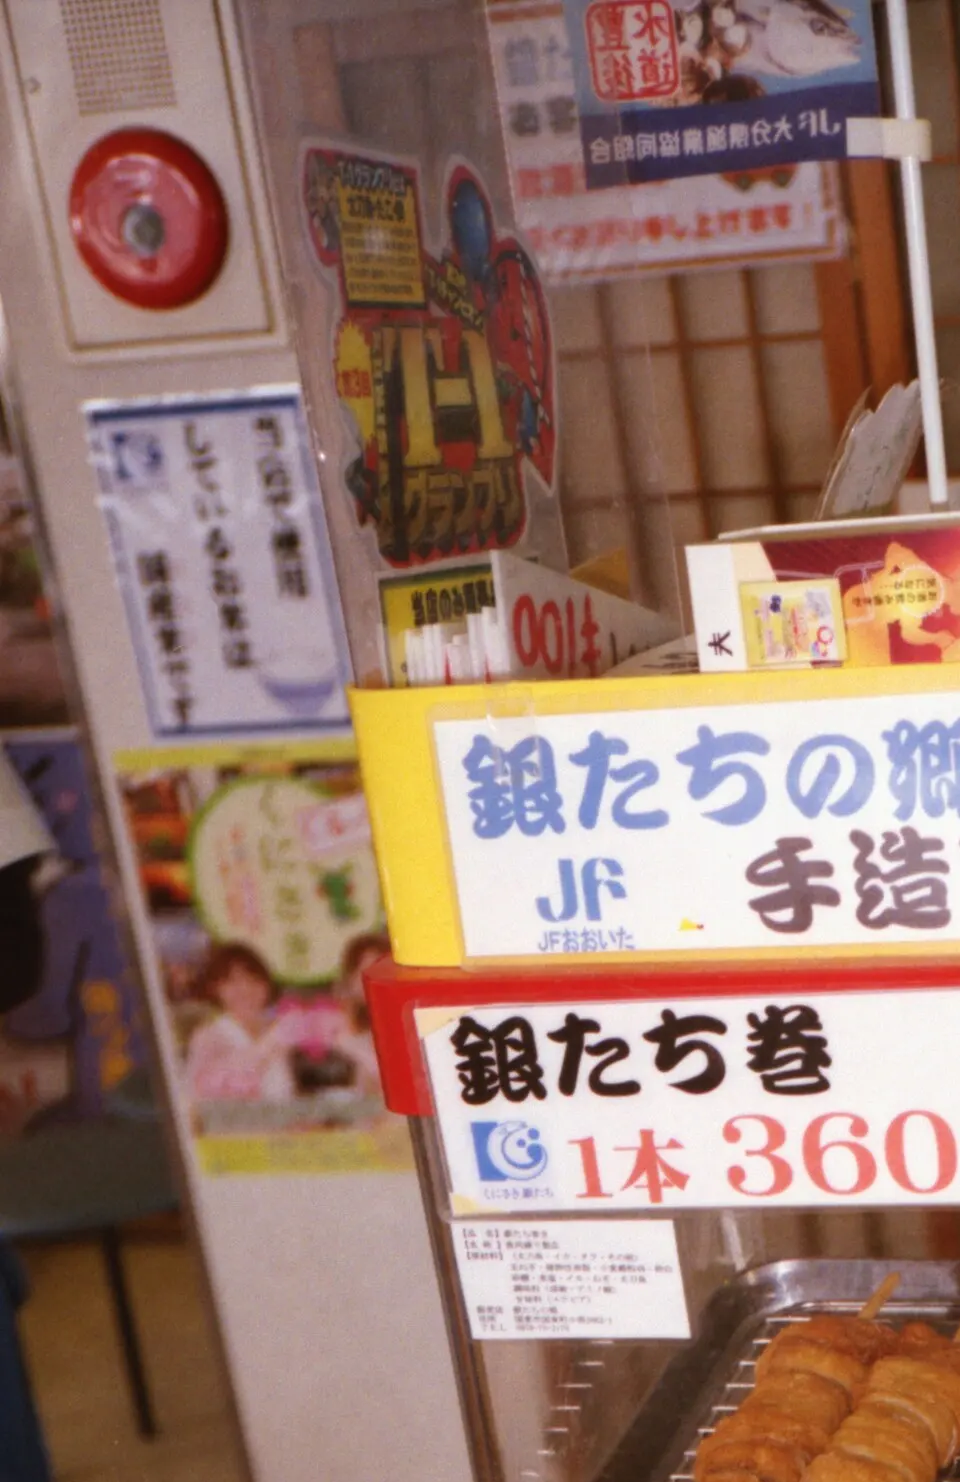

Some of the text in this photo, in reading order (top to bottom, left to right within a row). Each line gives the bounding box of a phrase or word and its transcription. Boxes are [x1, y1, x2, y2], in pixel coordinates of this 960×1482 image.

[536, 857, 627, 922] JF
[538, 928, 635, 953] JFおおいた
[450, 1004, 832, 1106] 銀たち巻
[568, 1128, 690, 1203] 1本
